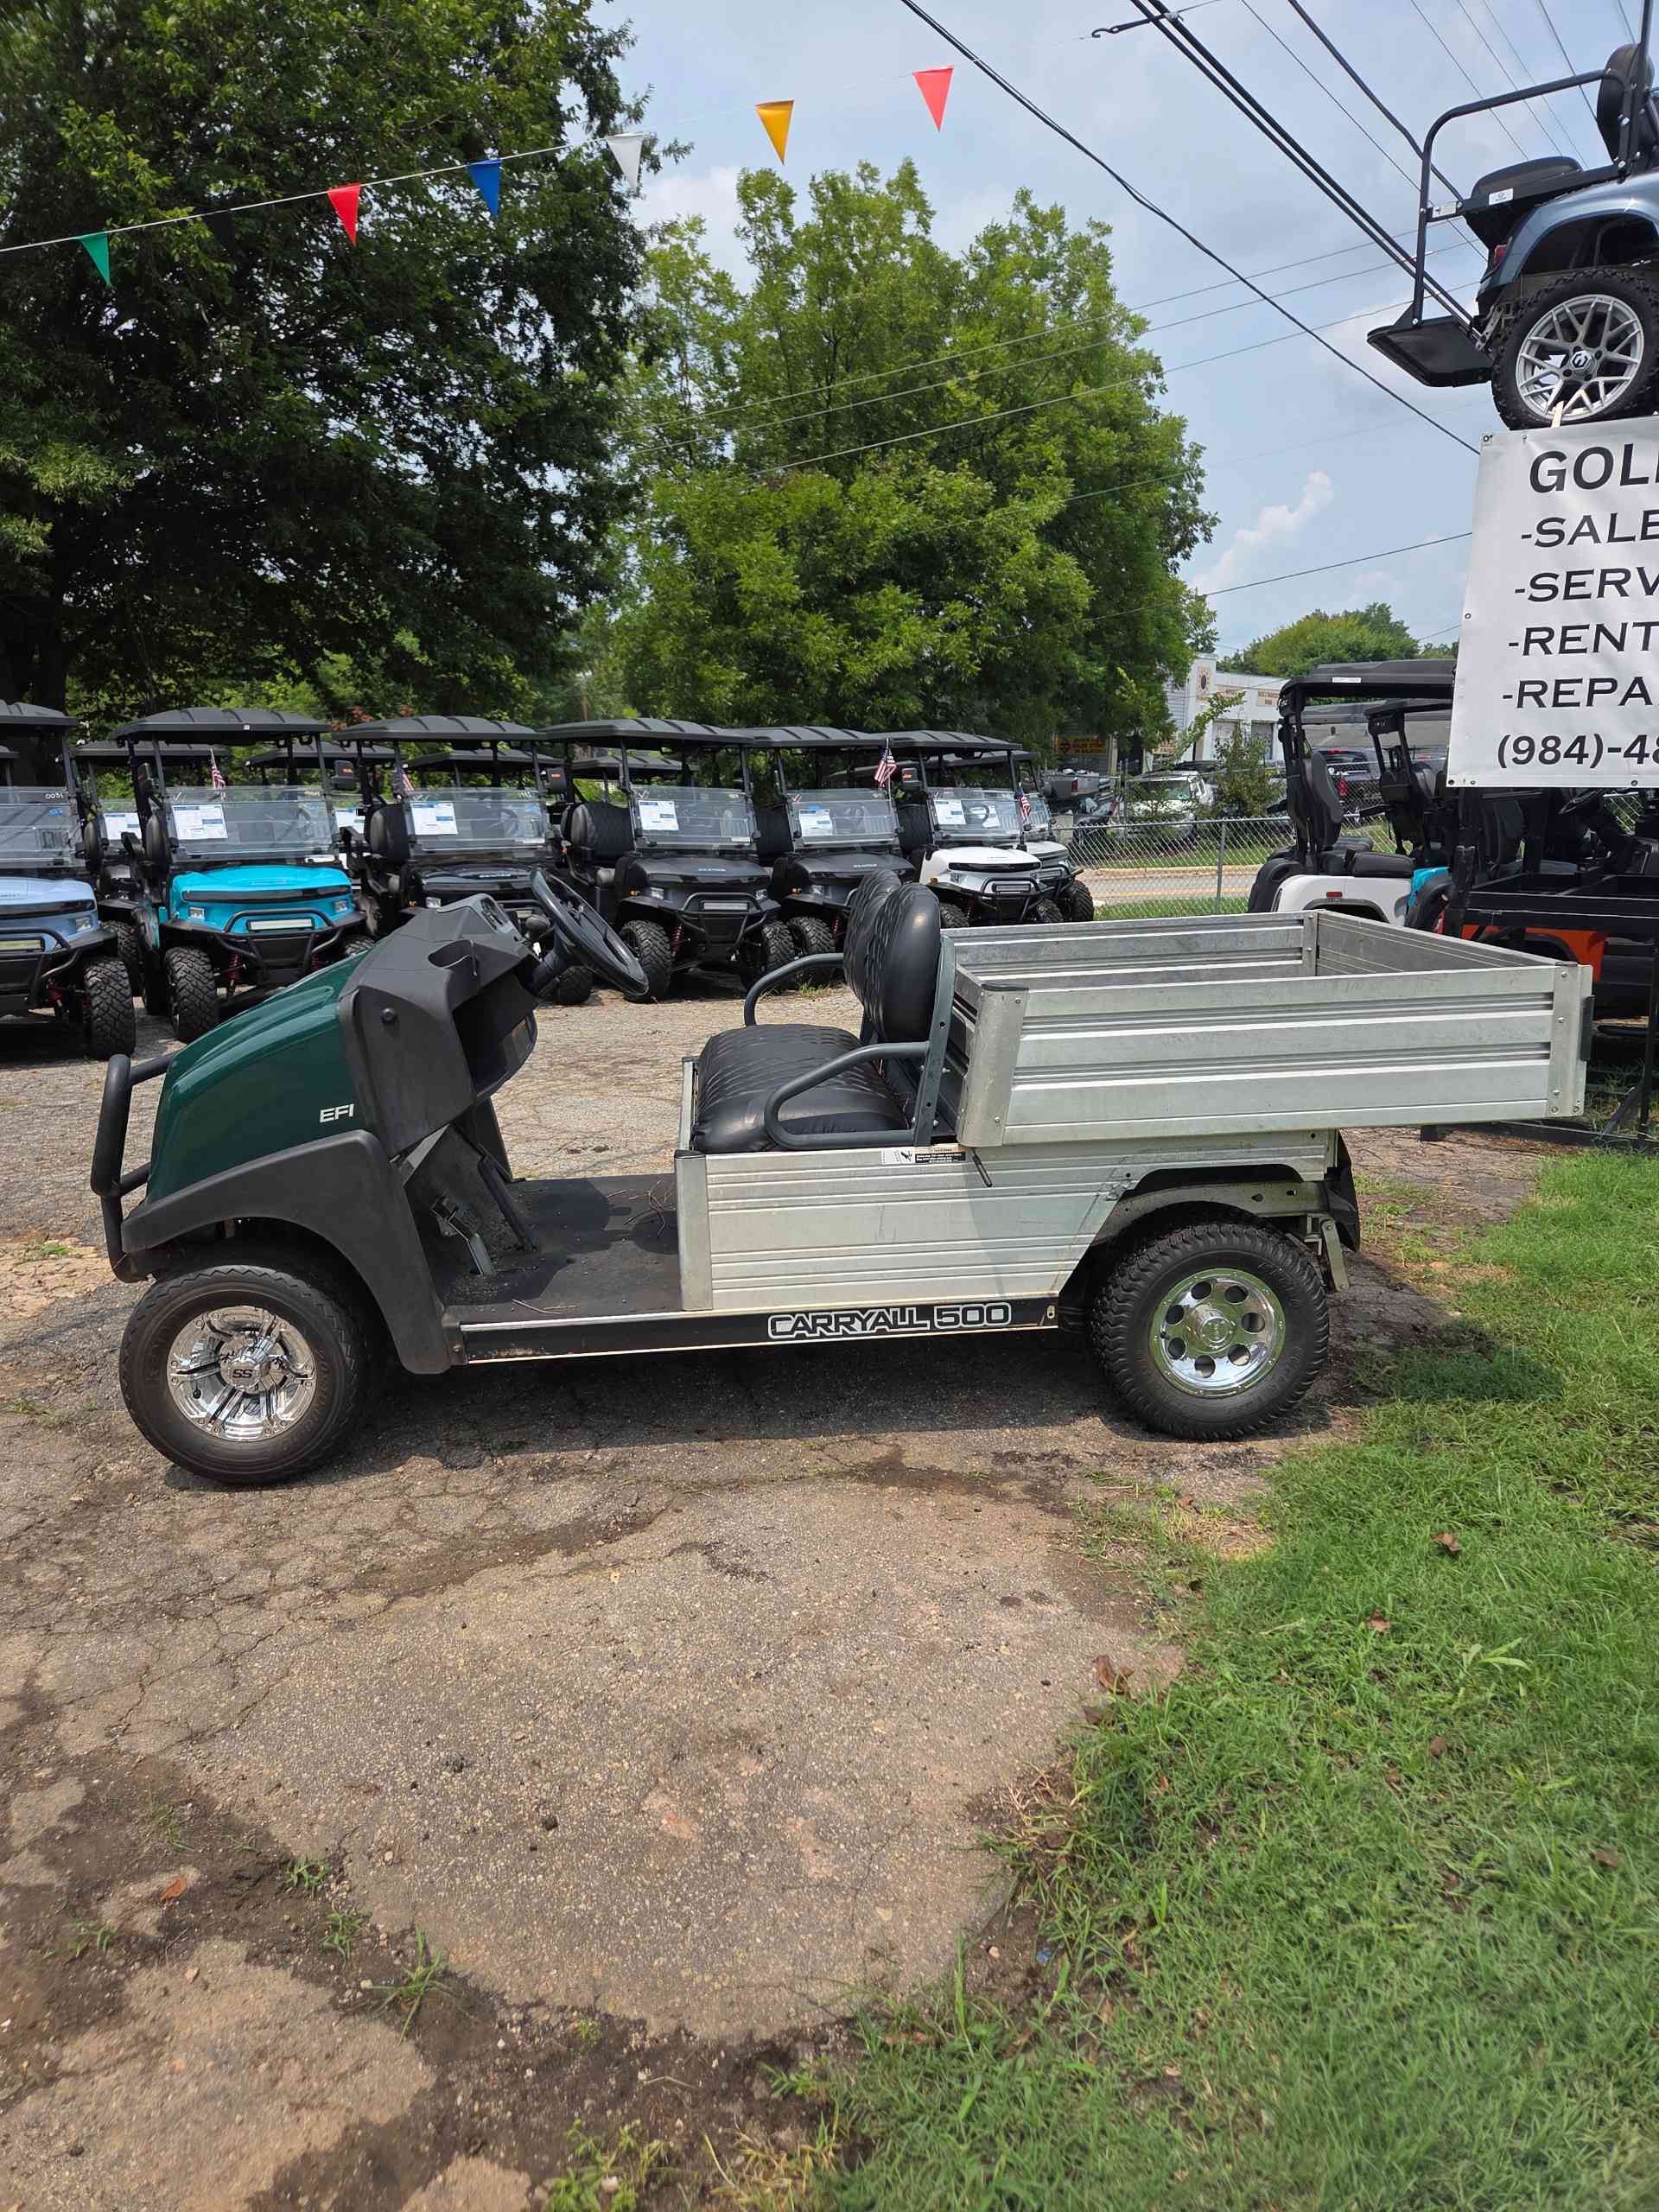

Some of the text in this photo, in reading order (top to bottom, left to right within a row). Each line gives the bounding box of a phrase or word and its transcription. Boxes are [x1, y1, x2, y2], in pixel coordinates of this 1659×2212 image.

[1529, 442, 1659, 493] GOL
[1521, 509, 1659, 548] -SALE
[1515, 566, 1659, 602] -SERV
[1508, 621, 1659, 657] -RENT
[1502, 676, 1659, 709] -REPA
[320, 1103, 354, 1122] EFI
[768, 1302, 1012, 1339] CARRYALL 500
